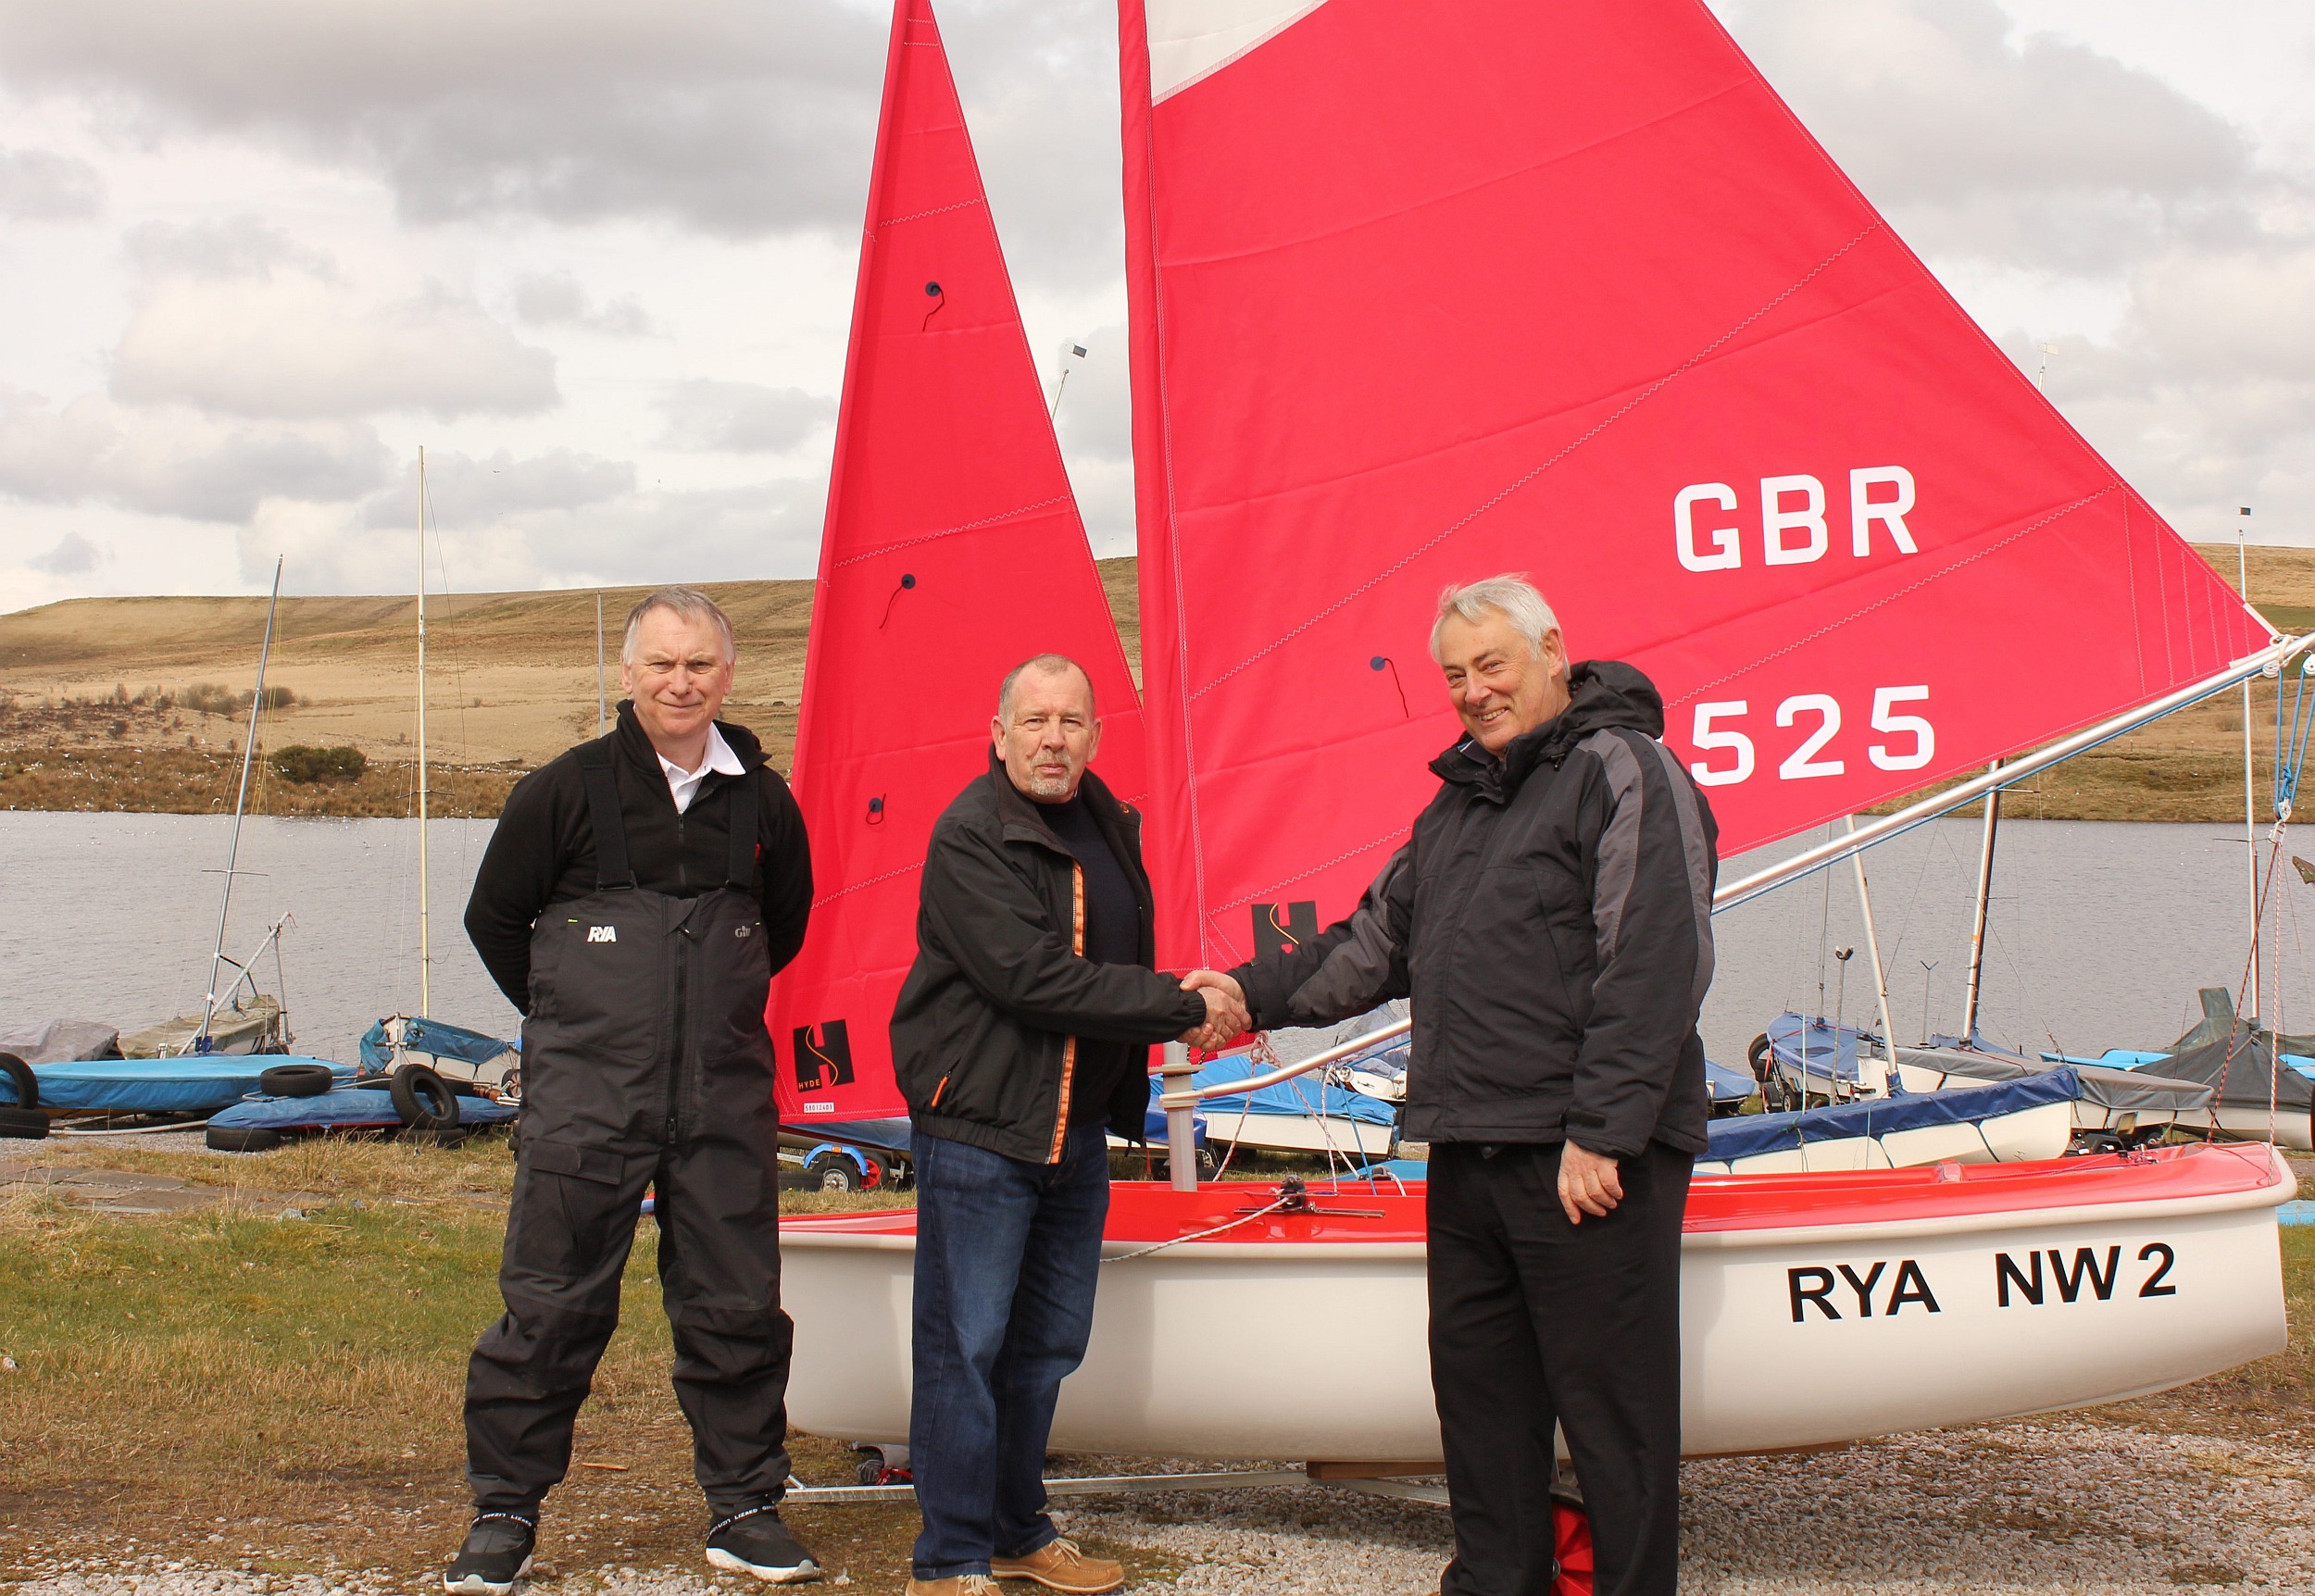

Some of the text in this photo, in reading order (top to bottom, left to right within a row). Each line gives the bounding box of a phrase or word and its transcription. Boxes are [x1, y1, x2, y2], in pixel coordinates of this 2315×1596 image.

[1673, 466, 1918, 572] GBR
[1656, 685, 1935, 786] 525
[587, 926, 617, 942] RYA
[734, 926, 751, 939] Gill
[798, 1079, 821, 1090] HYDE
[1787, 1260, 1941, 1323] RYA
